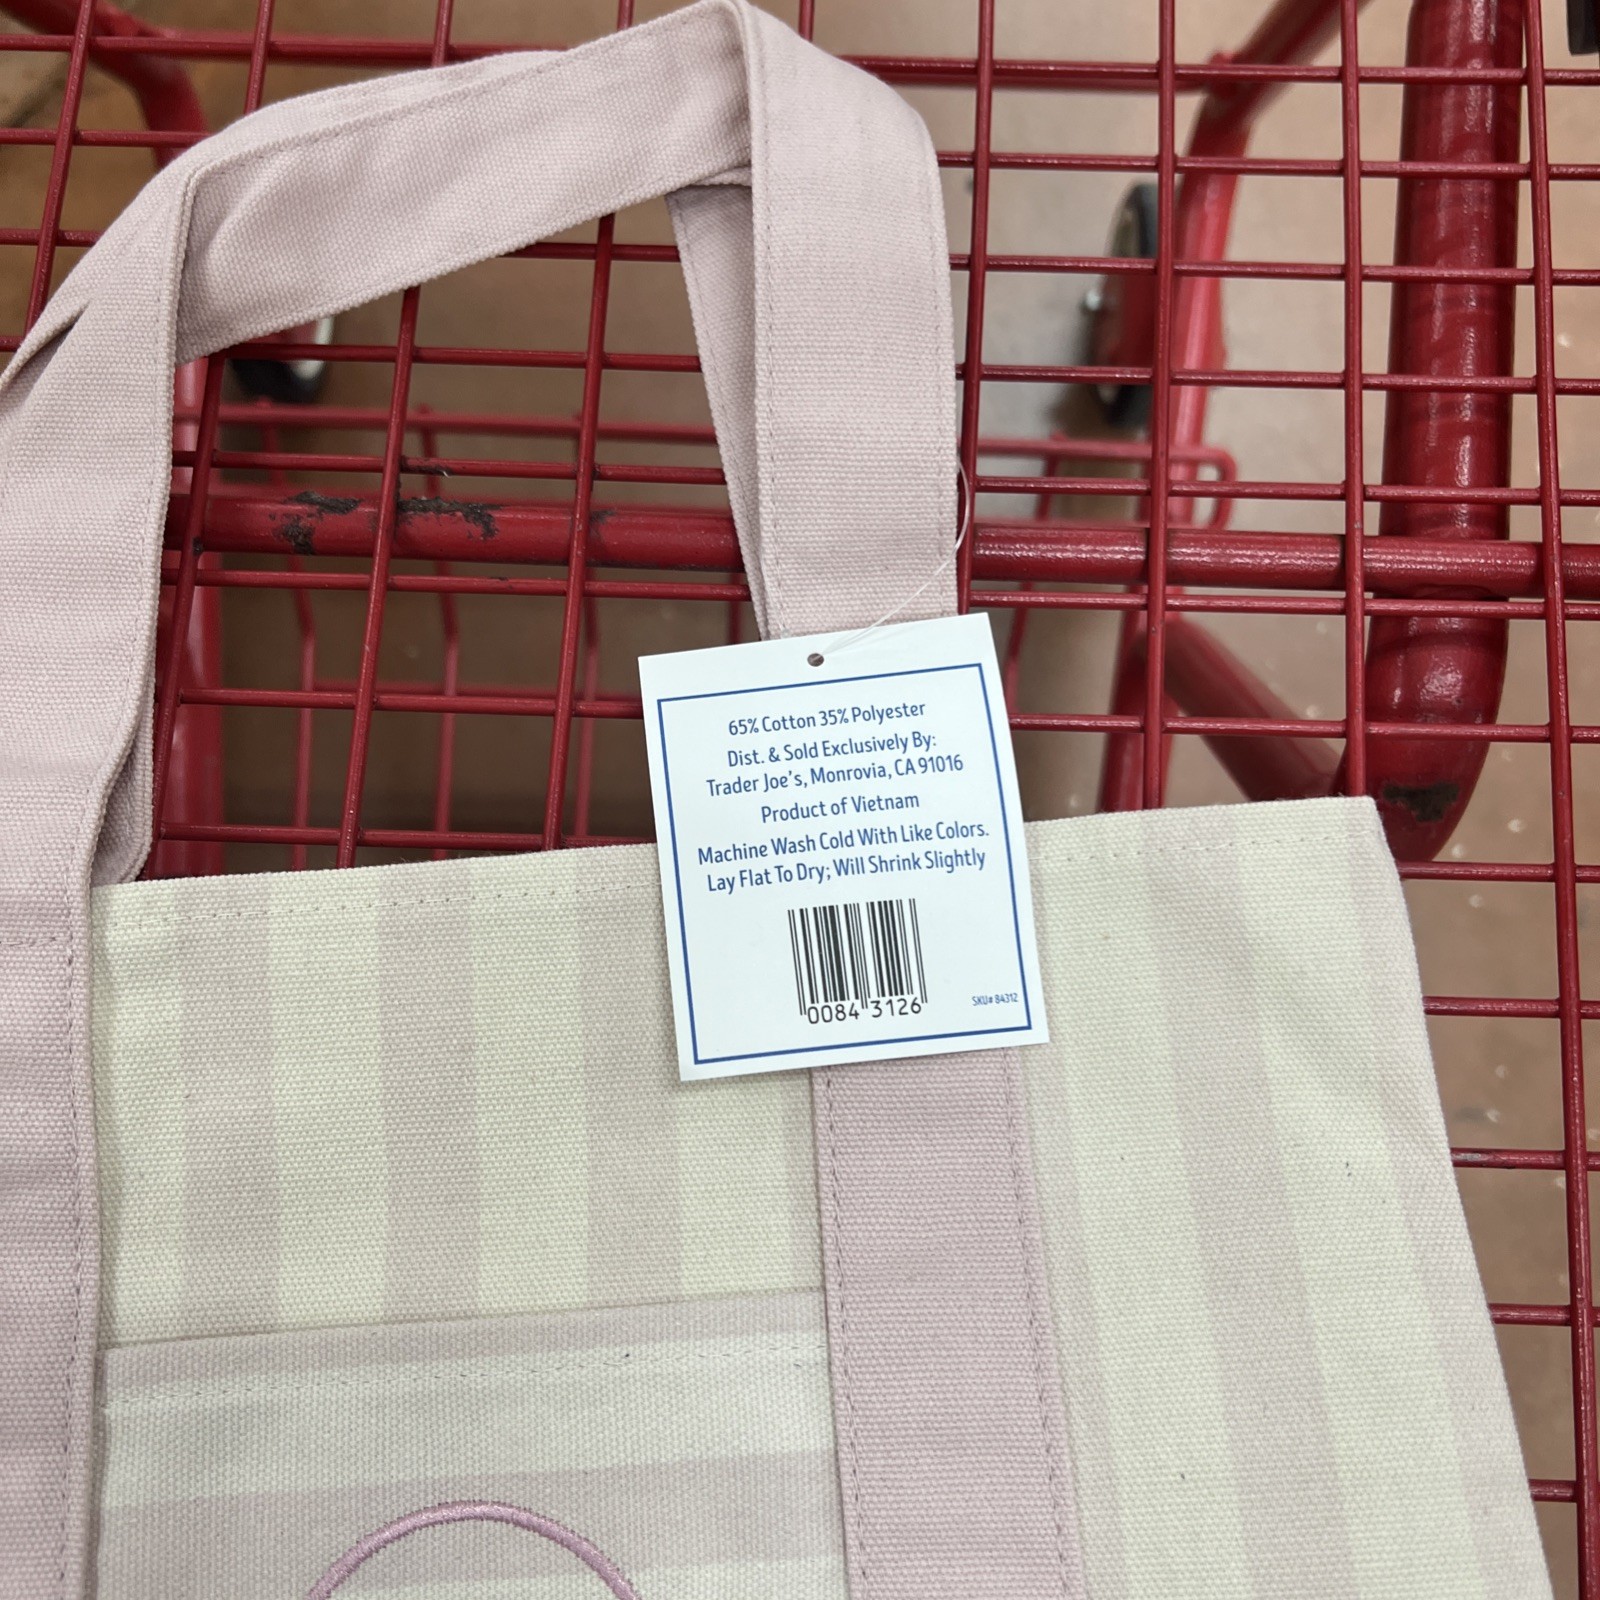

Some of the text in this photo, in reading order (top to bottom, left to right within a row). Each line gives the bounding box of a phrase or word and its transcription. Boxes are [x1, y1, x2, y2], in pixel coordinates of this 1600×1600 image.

[728, 702, 926, 736] 65% Cotton 35% Polyester
[728, 731, 937, 767] Dist. & Sold Exclusively By:
[706, 754, 964, 796] Trader Joe's, Monrovia, CA 91016
[762, 793, 920, 823] Product of Vietnam
[698, 821, 990, 865] Machine Wash Cold With Like Colors.
[708, 848, 986, 894] Lay Flat To Dry; Will Shrink Slightly
[808, 997, 922, 1024] 0084 3126
[972, 993, 1018, 1006] SKU# 84312
